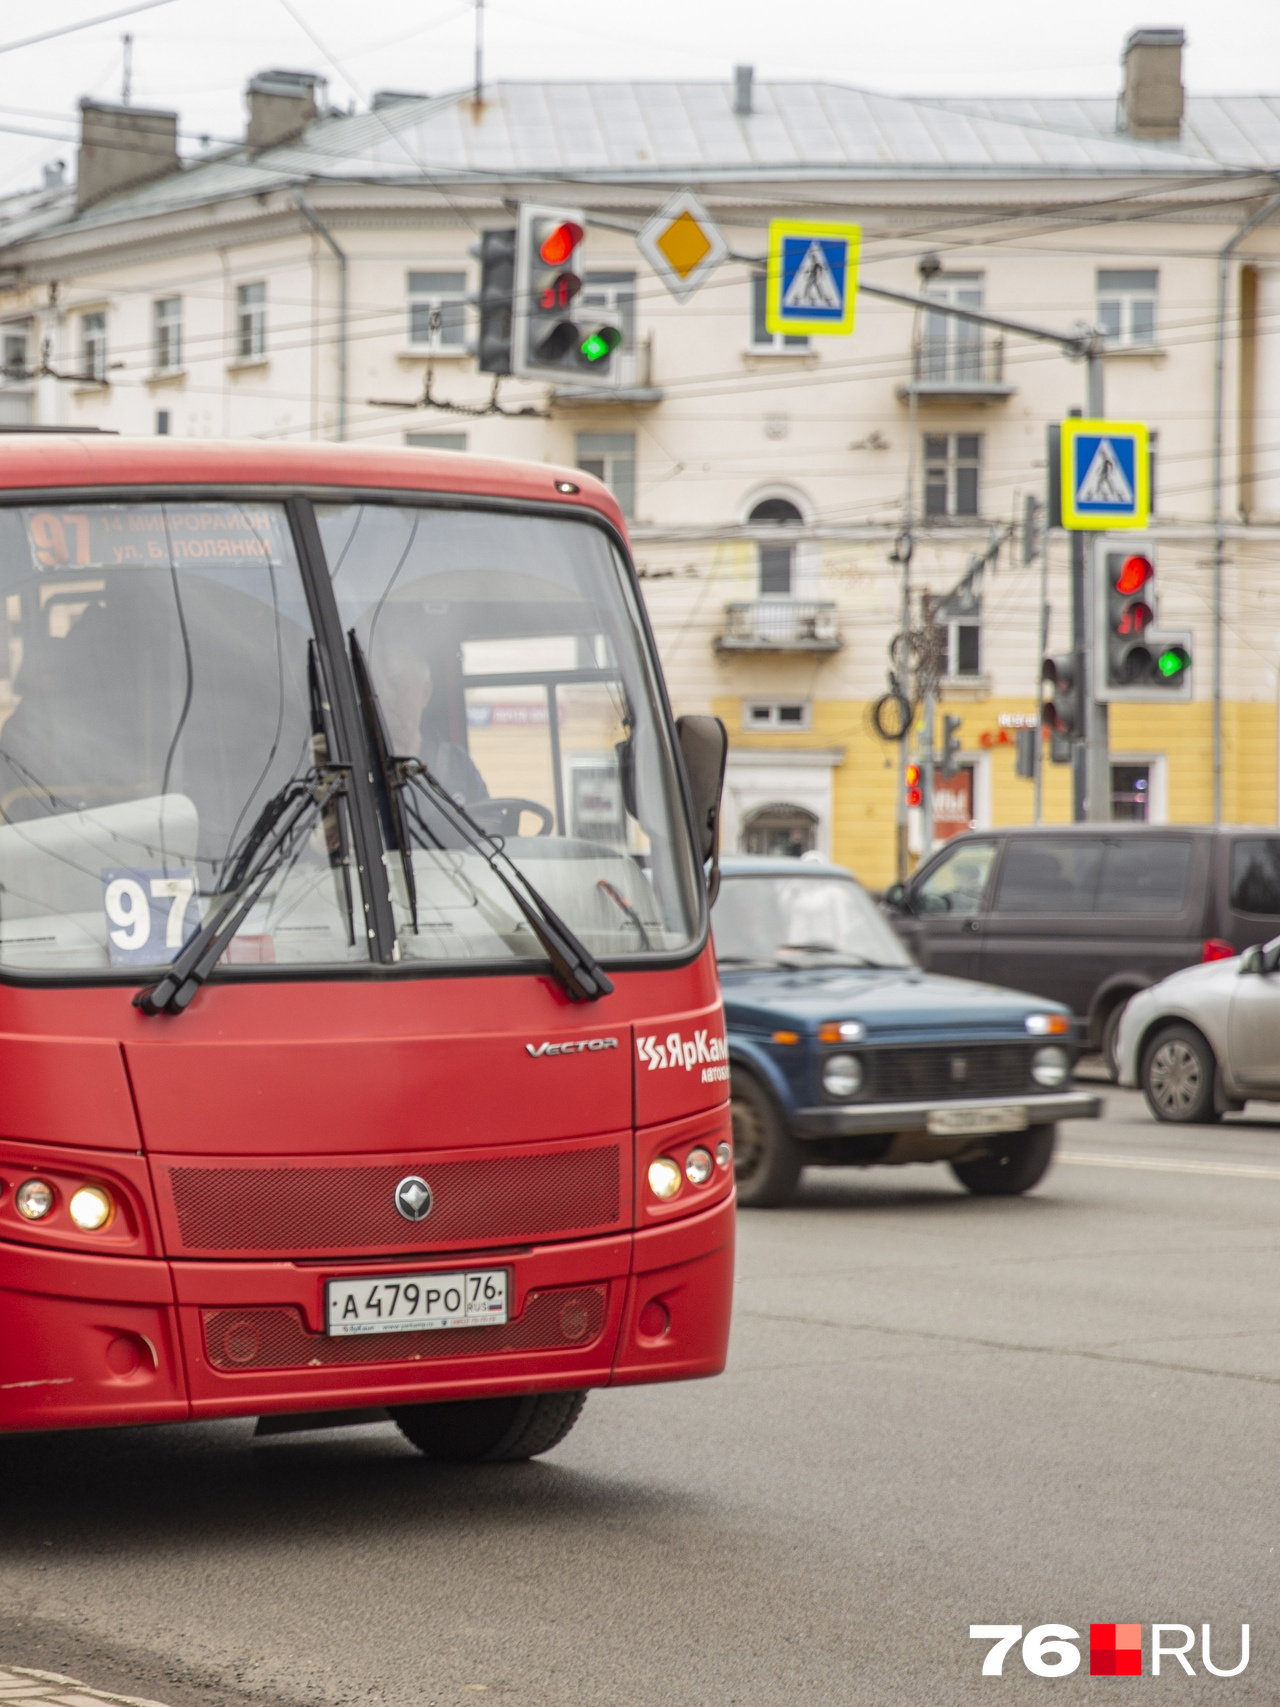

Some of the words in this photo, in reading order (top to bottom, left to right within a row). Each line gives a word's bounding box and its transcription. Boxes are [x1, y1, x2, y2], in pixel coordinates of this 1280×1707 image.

[30, 513, 91, 566] 97
[172, 538, 273, 559] ПОЛЯНКИ
[105, 878, 194, 950] 97
[524, 1036, 619, 1058] VECTOR
[468, 1275, 497, 1301] 76
[466, 1302, 488, 1313] RUS
